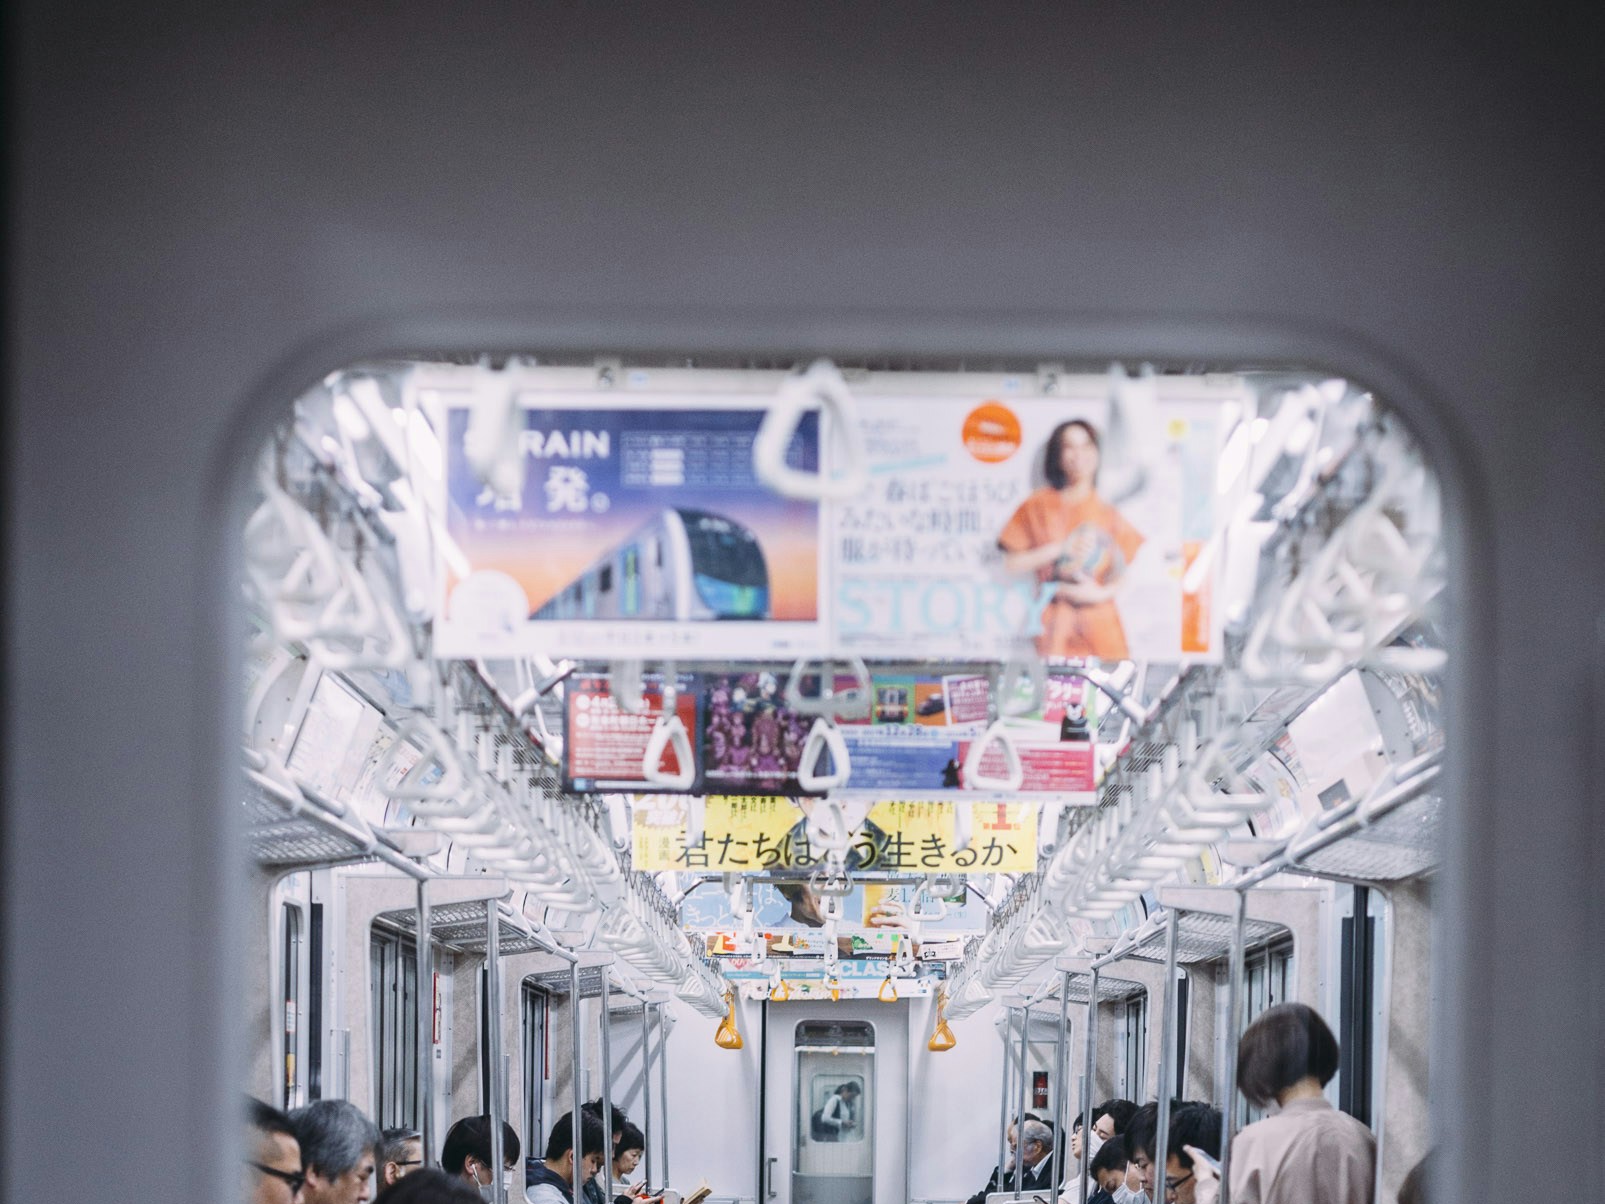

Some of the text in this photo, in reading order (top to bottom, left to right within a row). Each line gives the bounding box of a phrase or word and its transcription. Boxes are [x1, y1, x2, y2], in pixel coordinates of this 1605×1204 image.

[838, 581, 1058, 635] STORY
[675, 831, 1017, 869] 君たちはう生きるか
